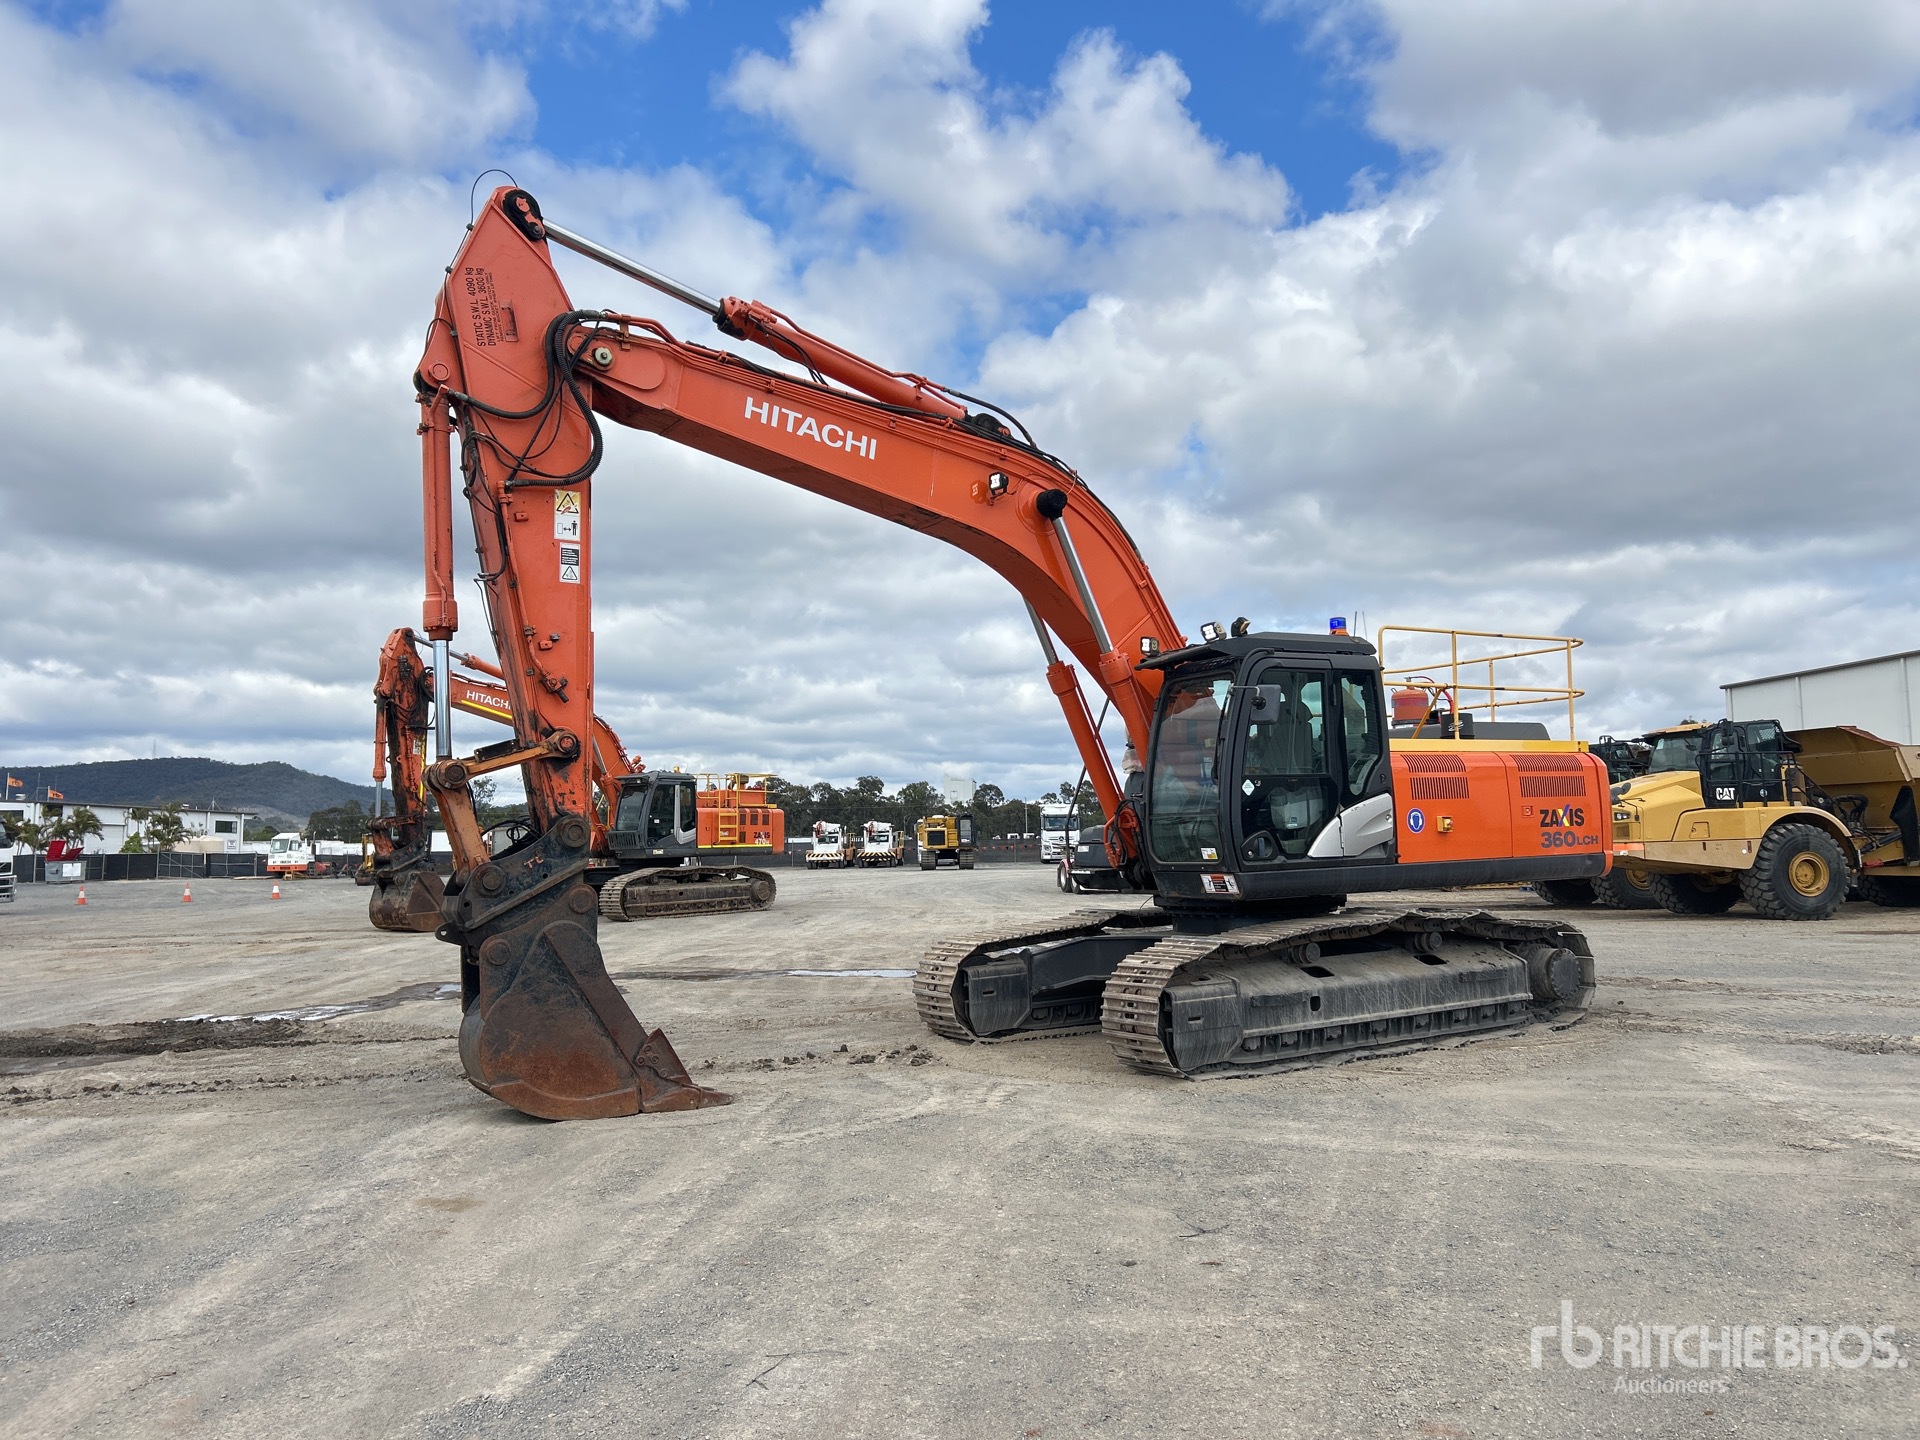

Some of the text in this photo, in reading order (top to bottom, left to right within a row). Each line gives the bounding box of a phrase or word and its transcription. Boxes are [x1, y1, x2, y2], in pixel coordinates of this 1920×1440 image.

[465, 267, 474, 275] kg
[466, 278, 476, 296] 4090
[474, 322, 486, 347] STATIC
[483, 317, 496, 346] DYNAMIC
[744, 396, 877, 460] HITACHI
[1716, 787, 1735, 801] CAT
[1539, 804, 1585, 828] ZAXIS
[753, 831, 771, 839] ZAXIS
